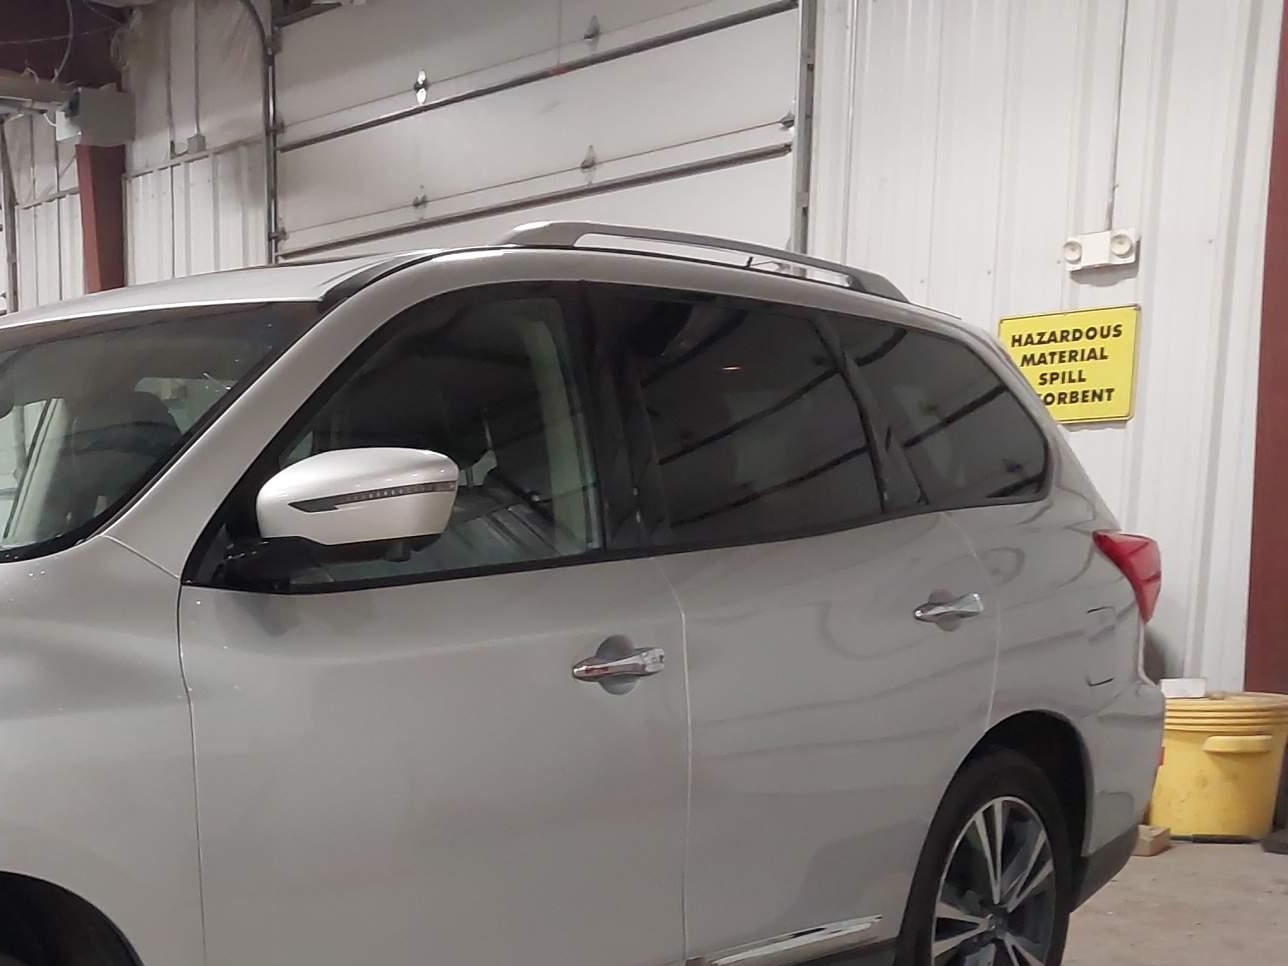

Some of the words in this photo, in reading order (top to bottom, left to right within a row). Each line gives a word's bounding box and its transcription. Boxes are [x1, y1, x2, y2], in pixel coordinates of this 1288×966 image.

[1011, 324, 1123, 347] HAZARDOUS
[1020, 347, 1108, 367] MATERIAL
[1038, 369, 1086, 386] SPILL
[1038, 388, 1115, 405] ORBENT
